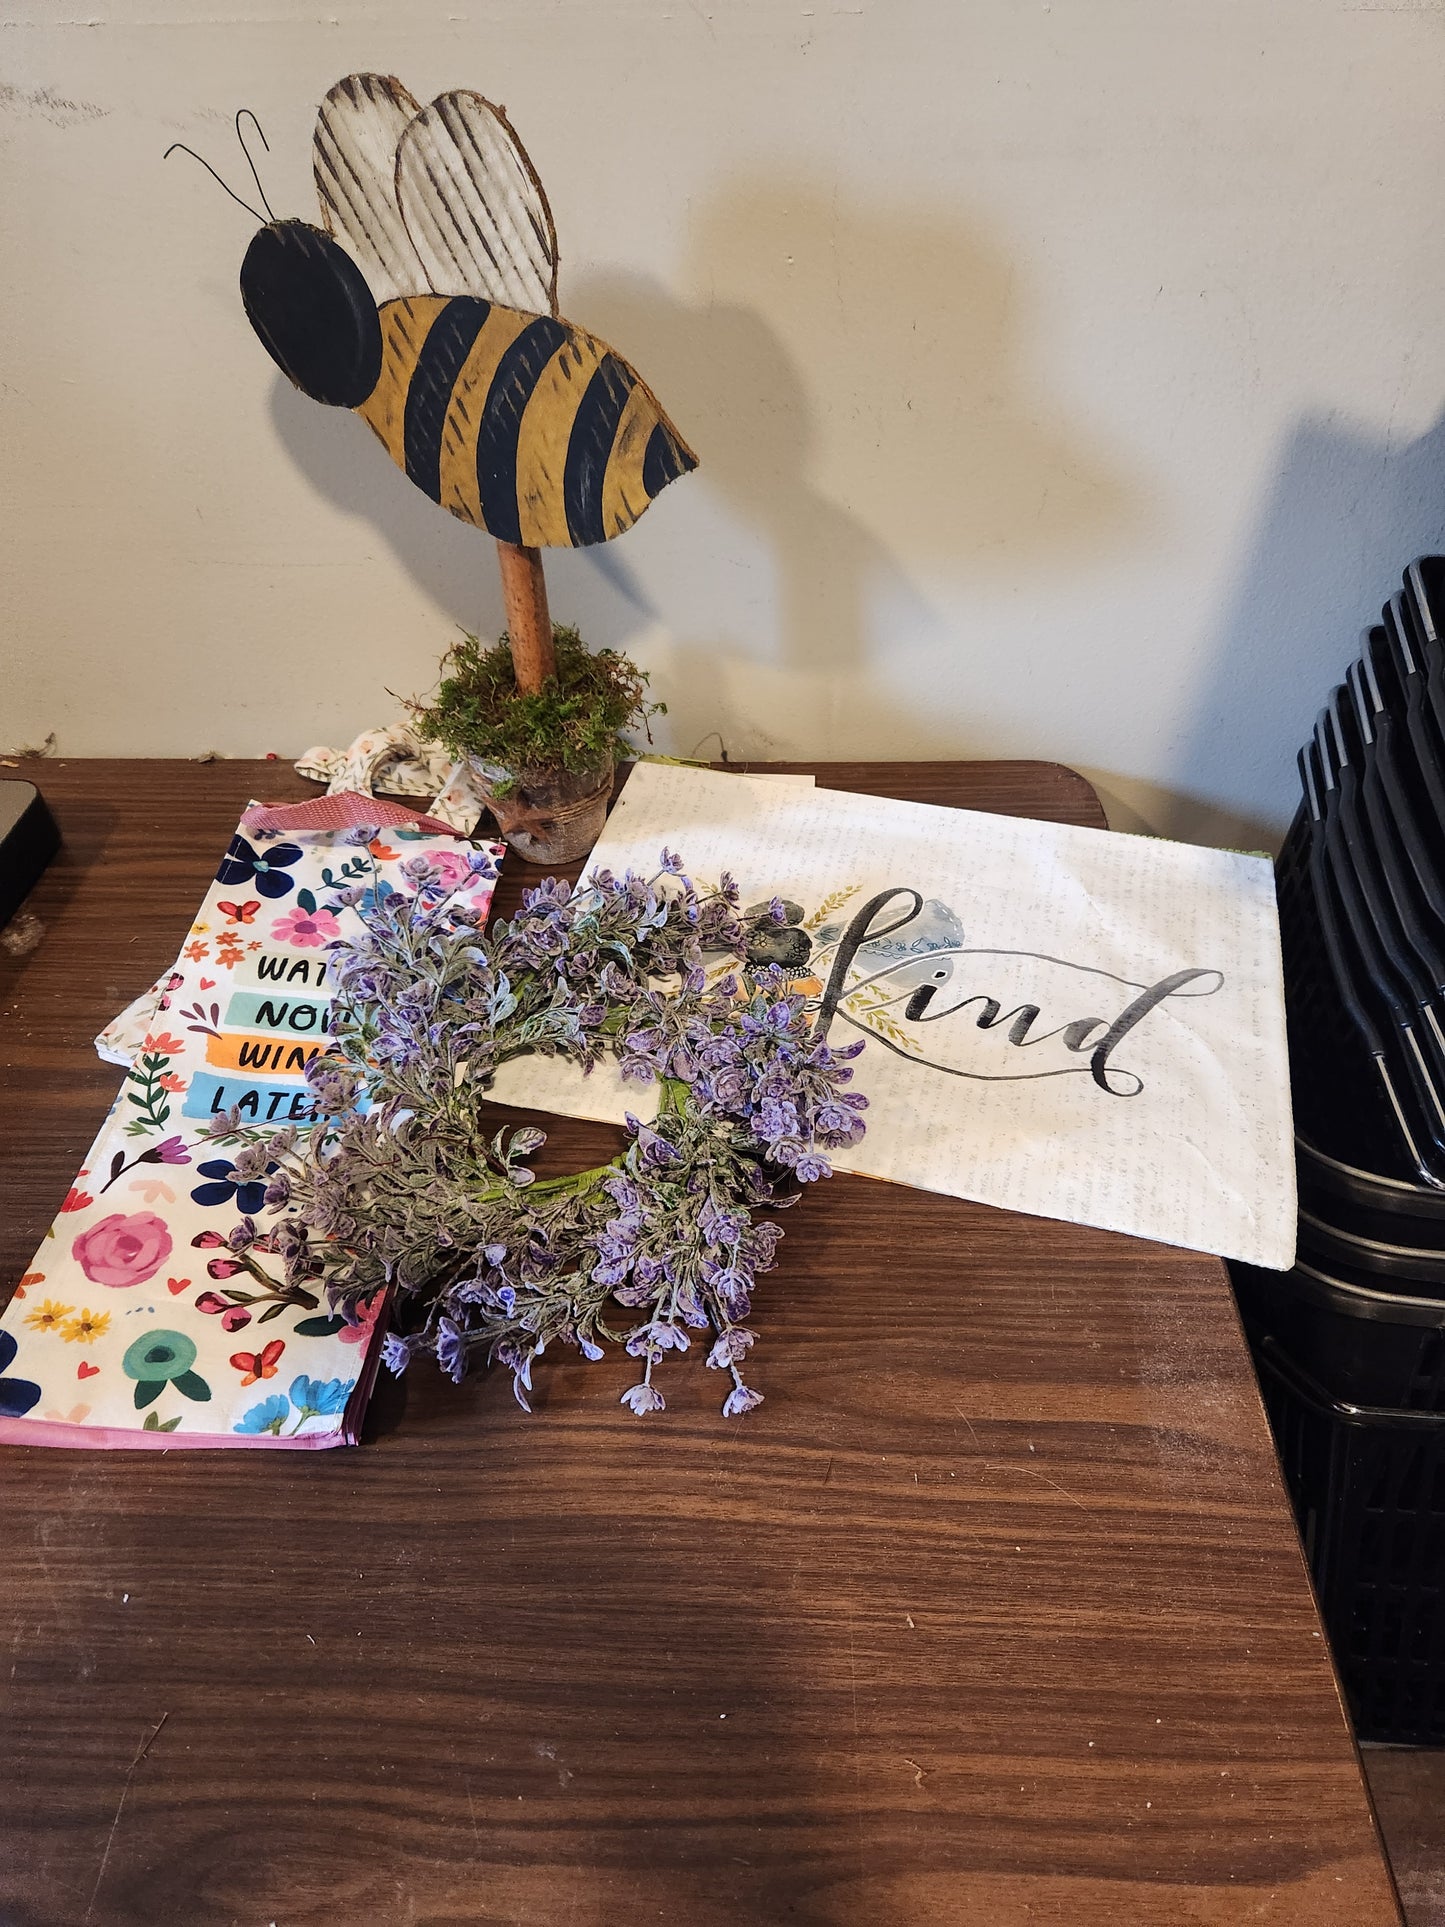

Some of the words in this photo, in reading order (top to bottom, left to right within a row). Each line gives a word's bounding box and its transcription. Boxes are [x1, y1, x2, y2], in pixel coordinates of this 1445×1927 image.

[257, 955, 338, 987] WAT
[808, 887, 1224, 1097] kind
[238, 1041, 341, 1070] WIN
